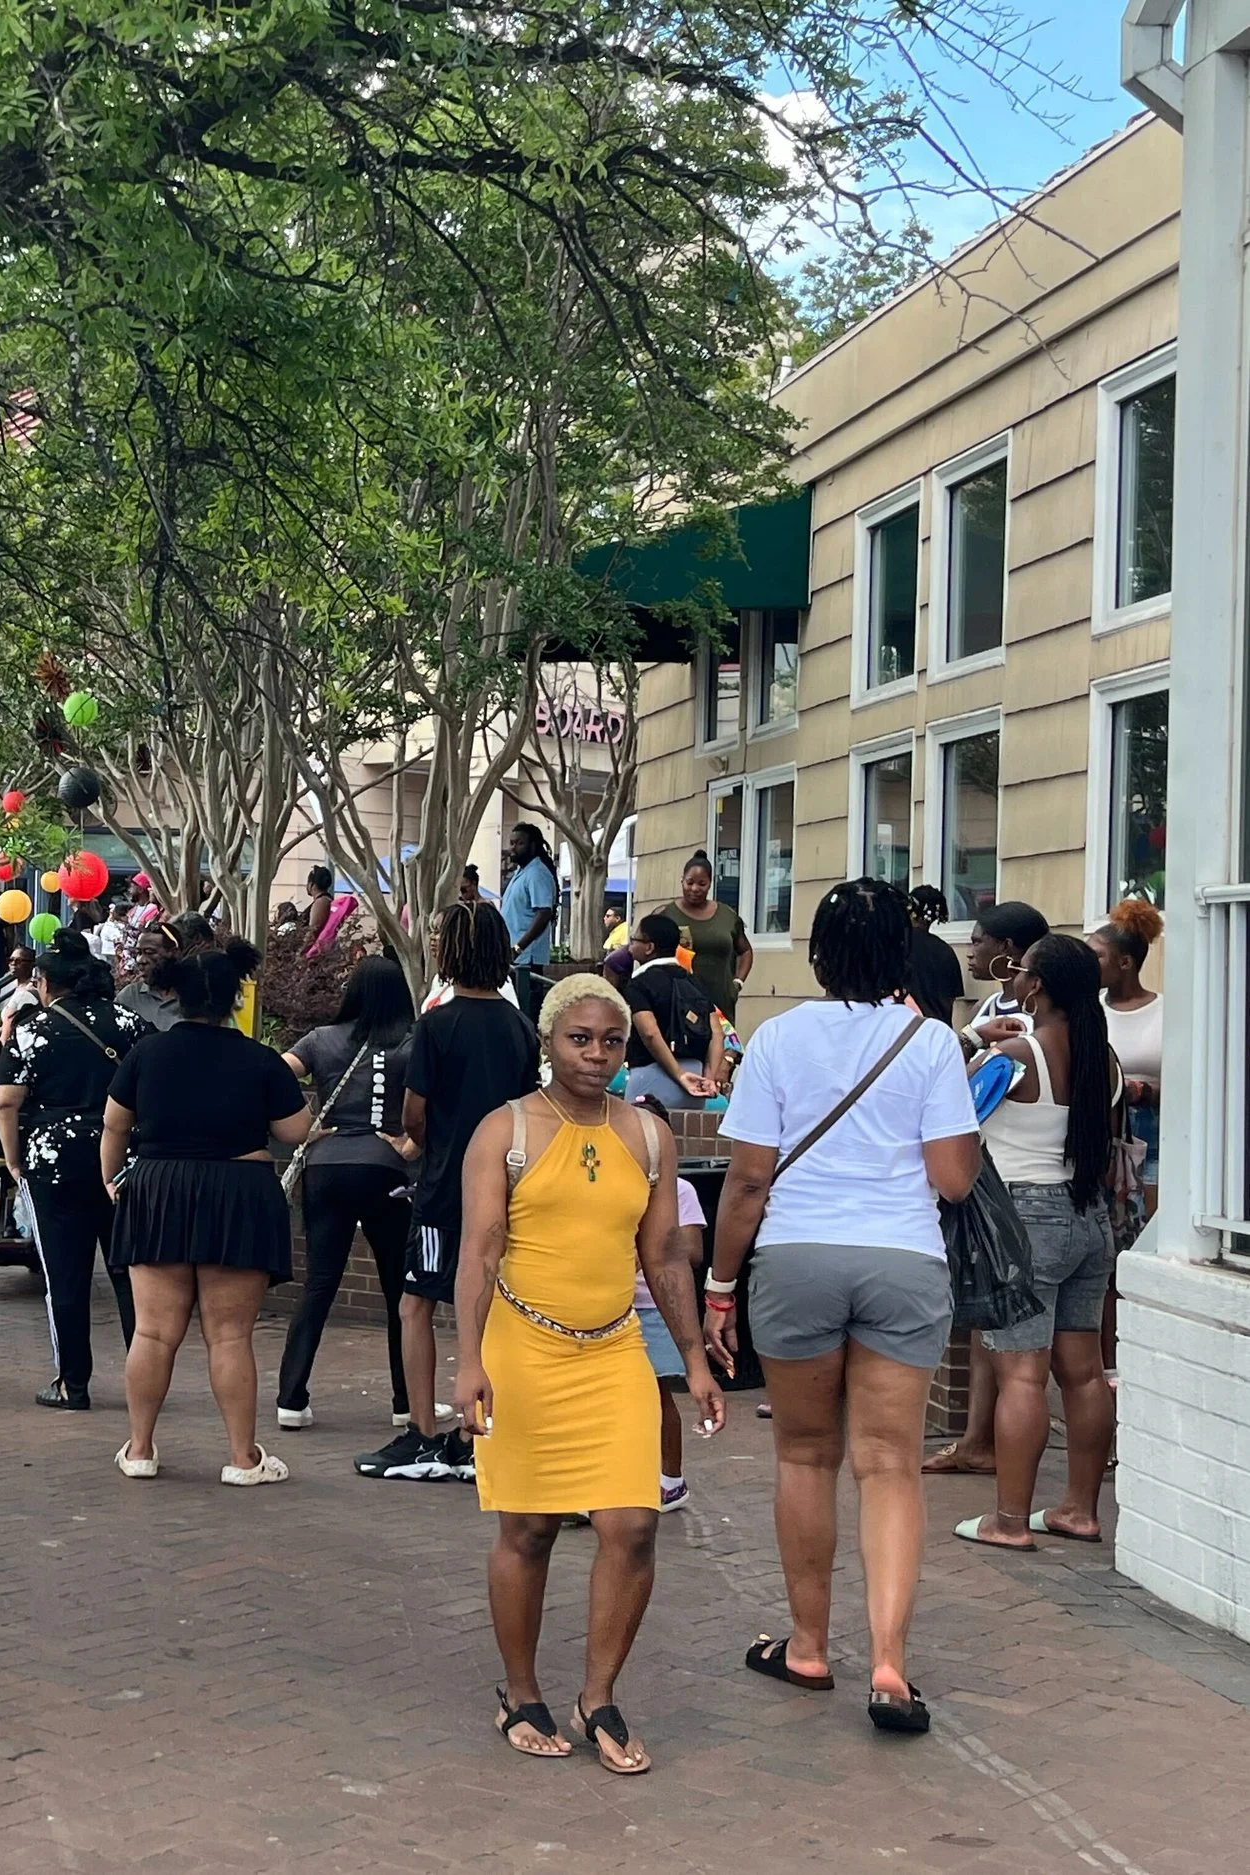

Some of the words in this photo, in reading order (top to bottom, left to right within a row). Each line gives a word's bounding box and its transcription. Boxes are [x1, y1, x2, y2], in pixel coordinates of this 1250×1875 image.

[373, 1050, 385, 1069] IT.
[373, 1072, 385, 1094] DO
[370, 1096, 384, 1128] JUST
